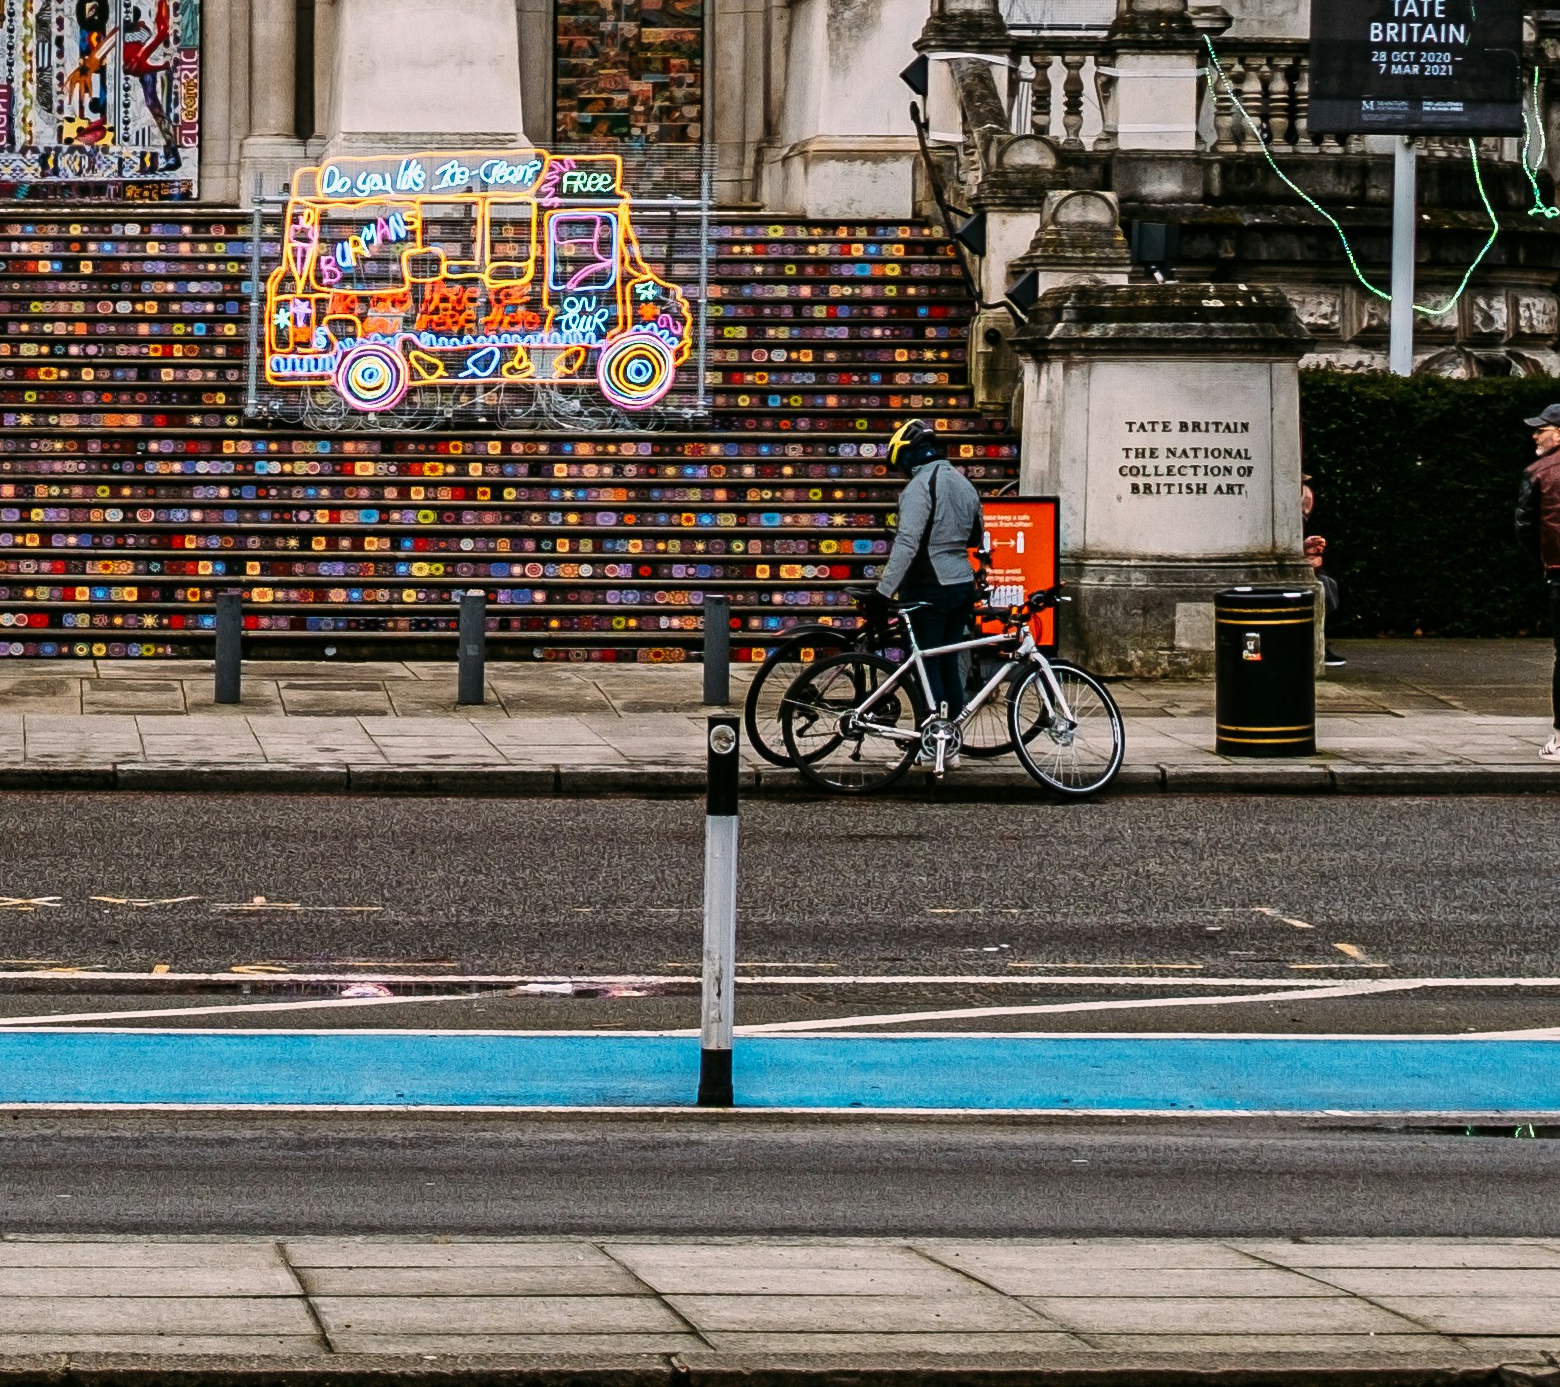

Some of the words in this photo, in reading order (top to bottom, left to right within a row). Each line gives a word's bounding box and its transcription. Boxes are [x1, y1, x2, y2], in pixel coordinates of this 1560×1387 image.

[1370, 22, 1465, 43] BRITAIN
[1371, 51, 1387, 62] 28
[1391, 52, 1416, 63] OCT
[1420, 52, 1451, 63] 2020
[1379, 64, 1387, 75] 7
[1391, 64, 1420, 75] MAR
[1424, 65, 1453, 76] 2021
[322, 165, 351, 194] Do
[320, 210, 421, 284] BURMANS
[562, 295, 598, 313] ON
[1125, 421, 1172, 433] TATE
[1179, 421, 1250, 434] BRITAIN
[1122, 448, 1159, 459] THE
[1166, 448, 1251, 460] NATIONAL
[1118, 465, 1232, 477] COLLECTION
[1236, 466, 1254, 477] OF
[1130, 483, 1207, 494] BRITISH
[1213, 483, 1245, 495] ART
